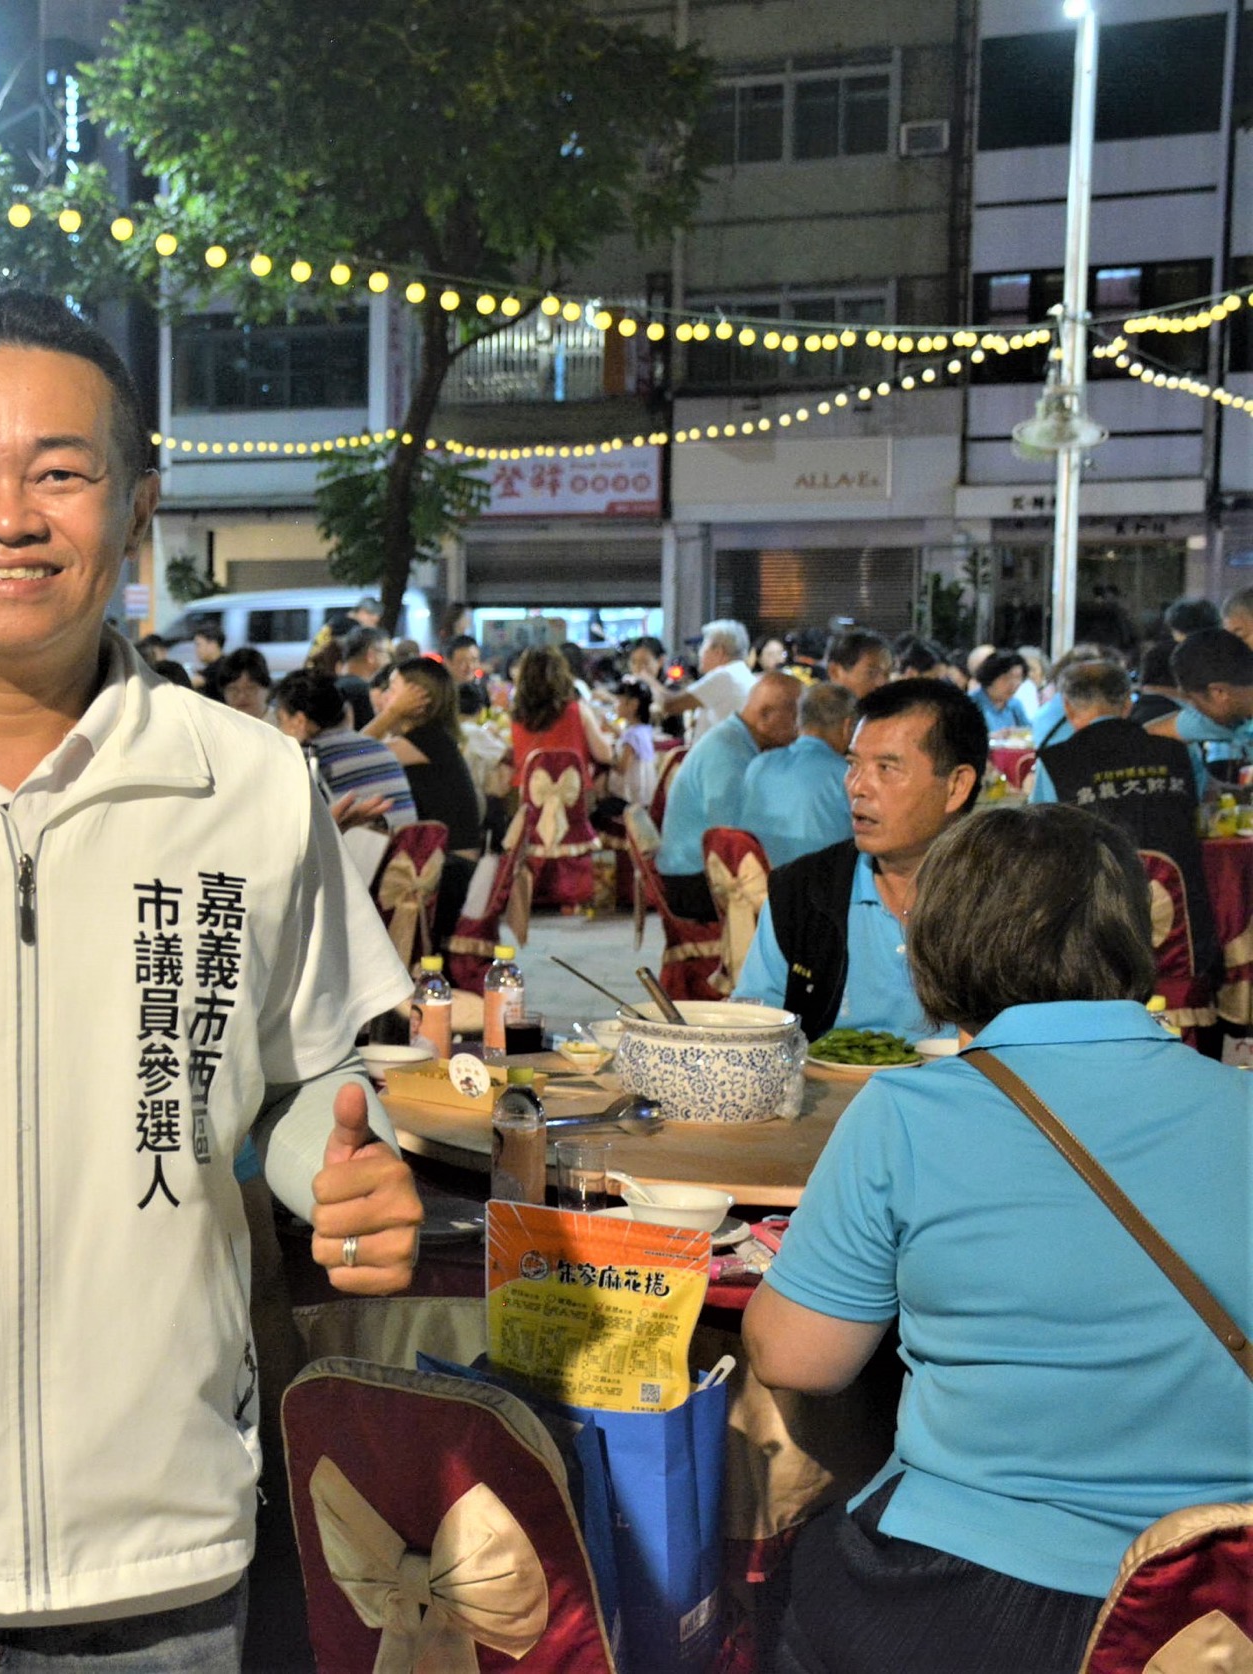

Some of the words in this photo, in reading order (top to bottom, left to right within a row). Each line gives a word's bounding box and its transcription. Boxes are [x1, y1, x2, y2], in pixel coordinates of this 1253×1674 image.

[133, 878, 184, 1209] 市議員參選人
[557, 1259, 670, 1298] 朱家麻花捲
